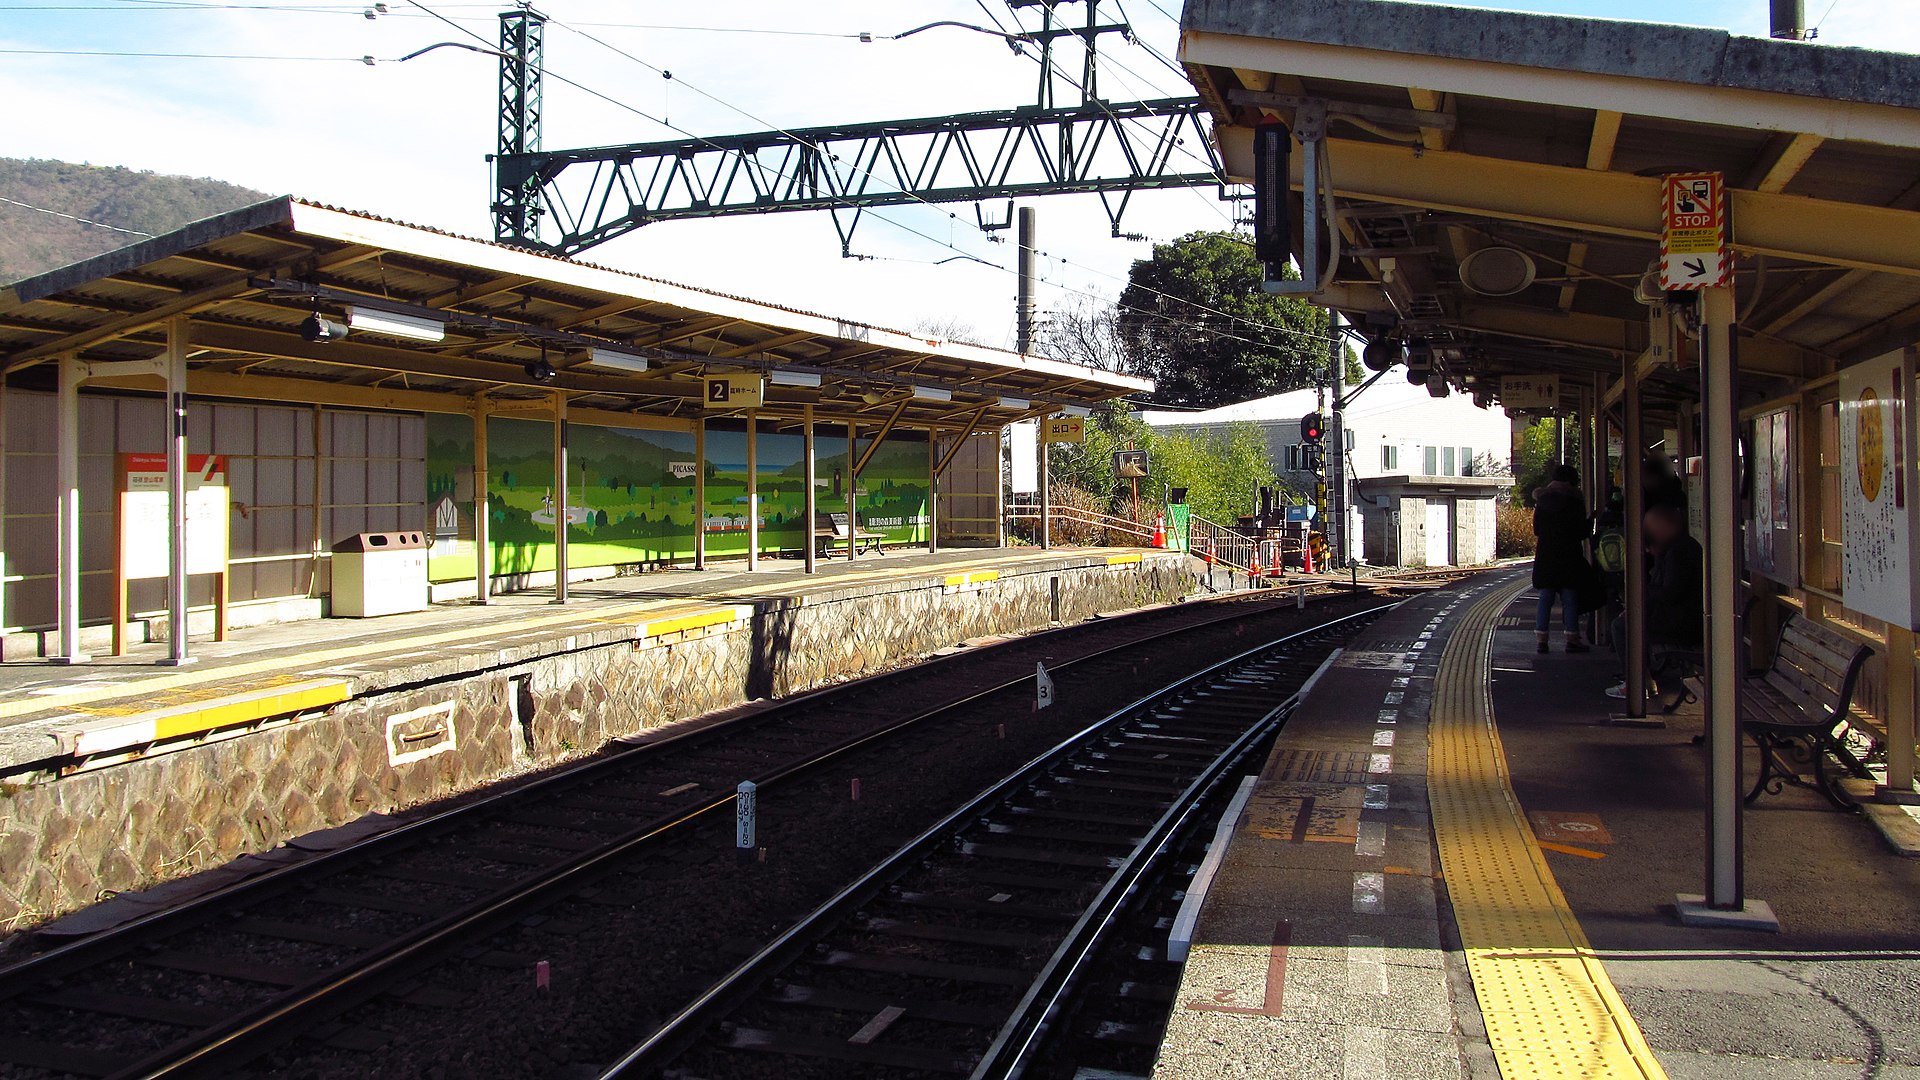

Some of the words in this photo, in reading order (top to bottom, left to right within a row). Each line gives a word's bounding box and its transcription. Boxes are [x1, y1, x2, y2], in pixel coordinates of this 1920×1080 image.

[1675, 215, 1711, 227] STOP
[714, 383, 724, 399] 2
[1504, 381, 1532, 391] お手洗
[1052, 424, 1069, 433] 出口
[1040, 686, 1048, 698] 3
